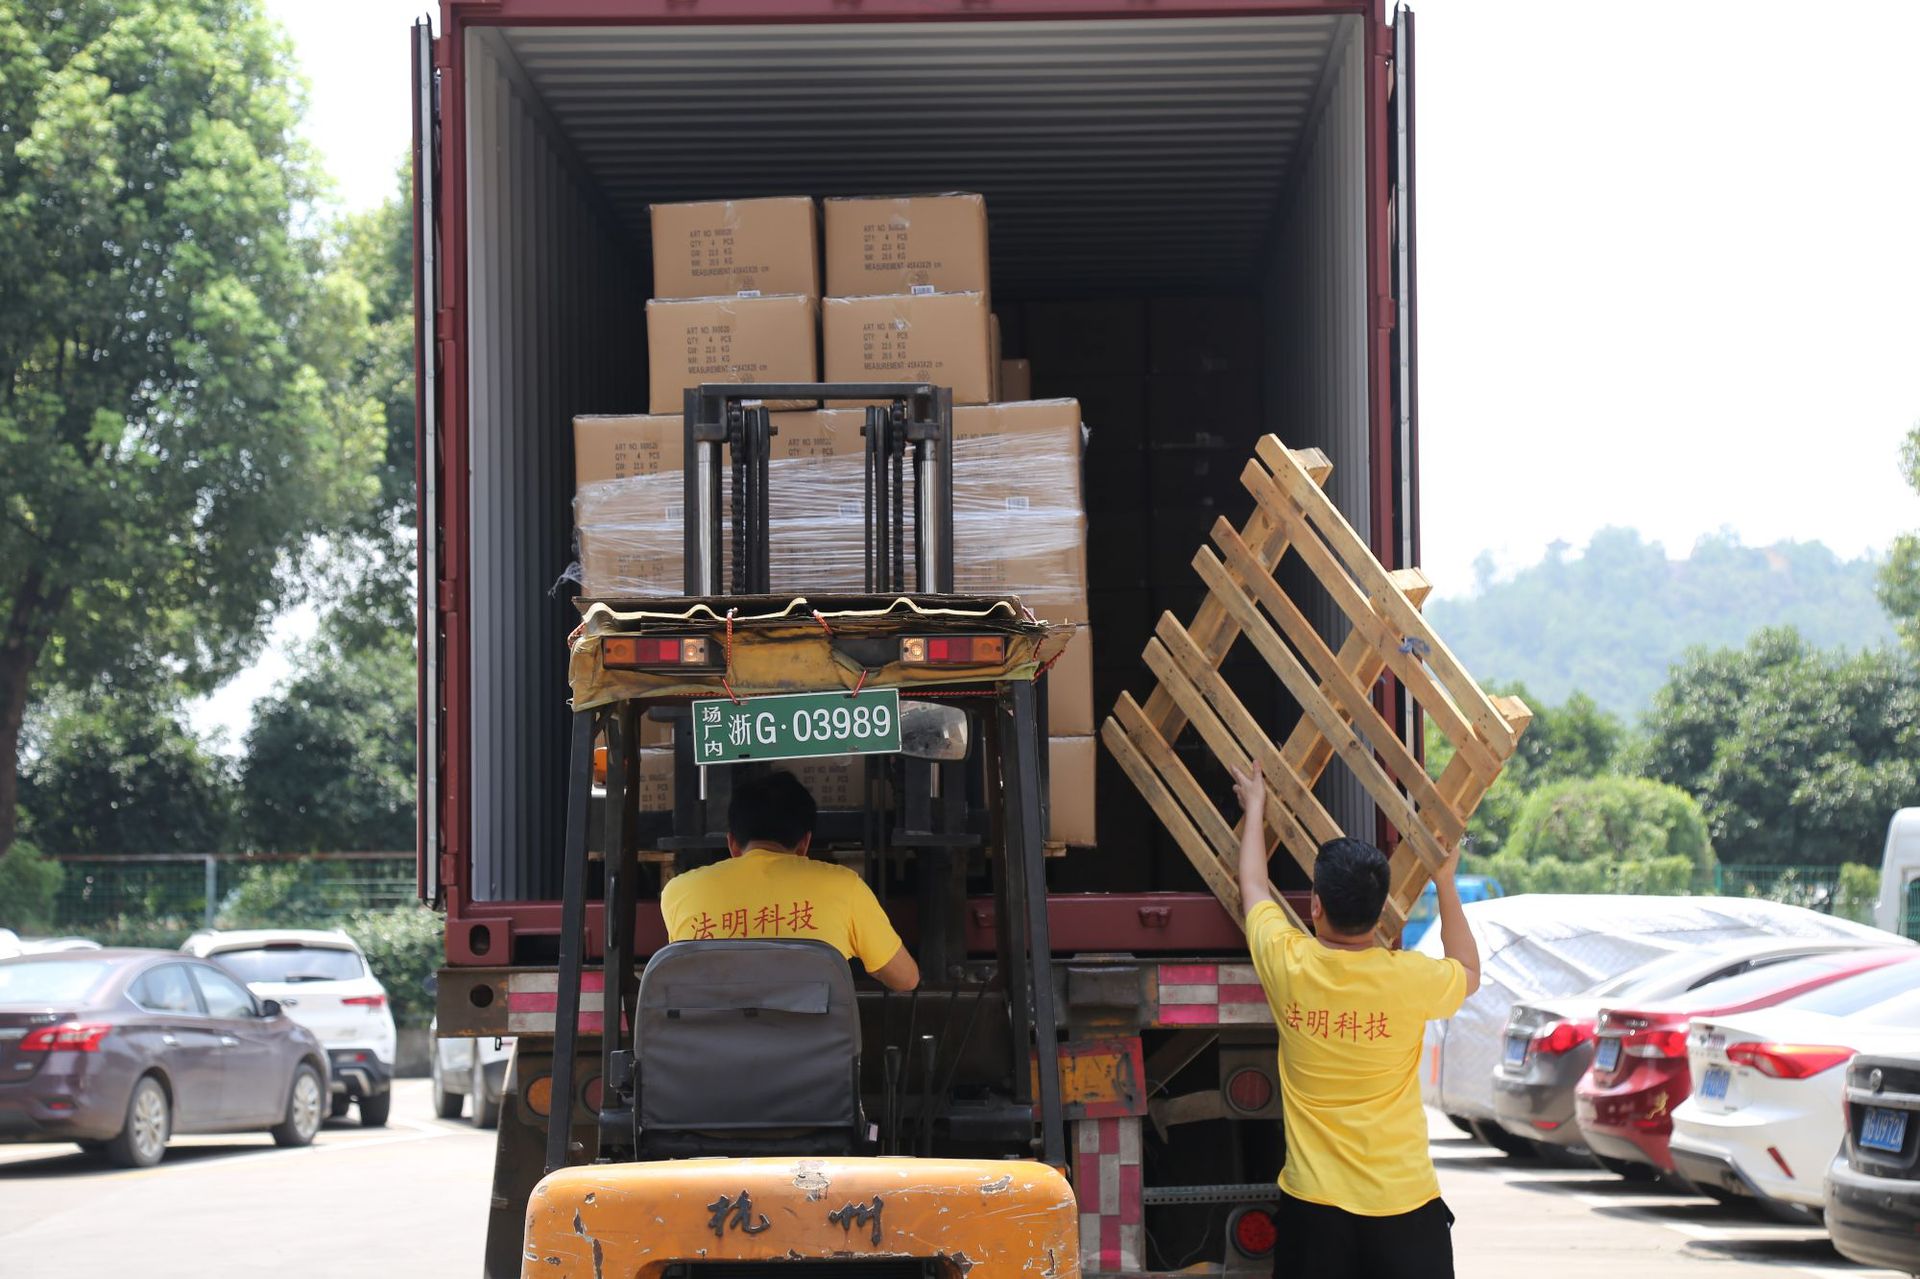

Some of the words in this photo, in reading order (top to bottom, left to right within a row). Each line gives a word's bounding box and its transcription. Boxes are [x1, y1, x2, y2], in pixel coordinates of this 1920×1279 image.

[691, 900, 819, 940] 法明科技
[1286, 1000, 1392, 1042] 法明科技
